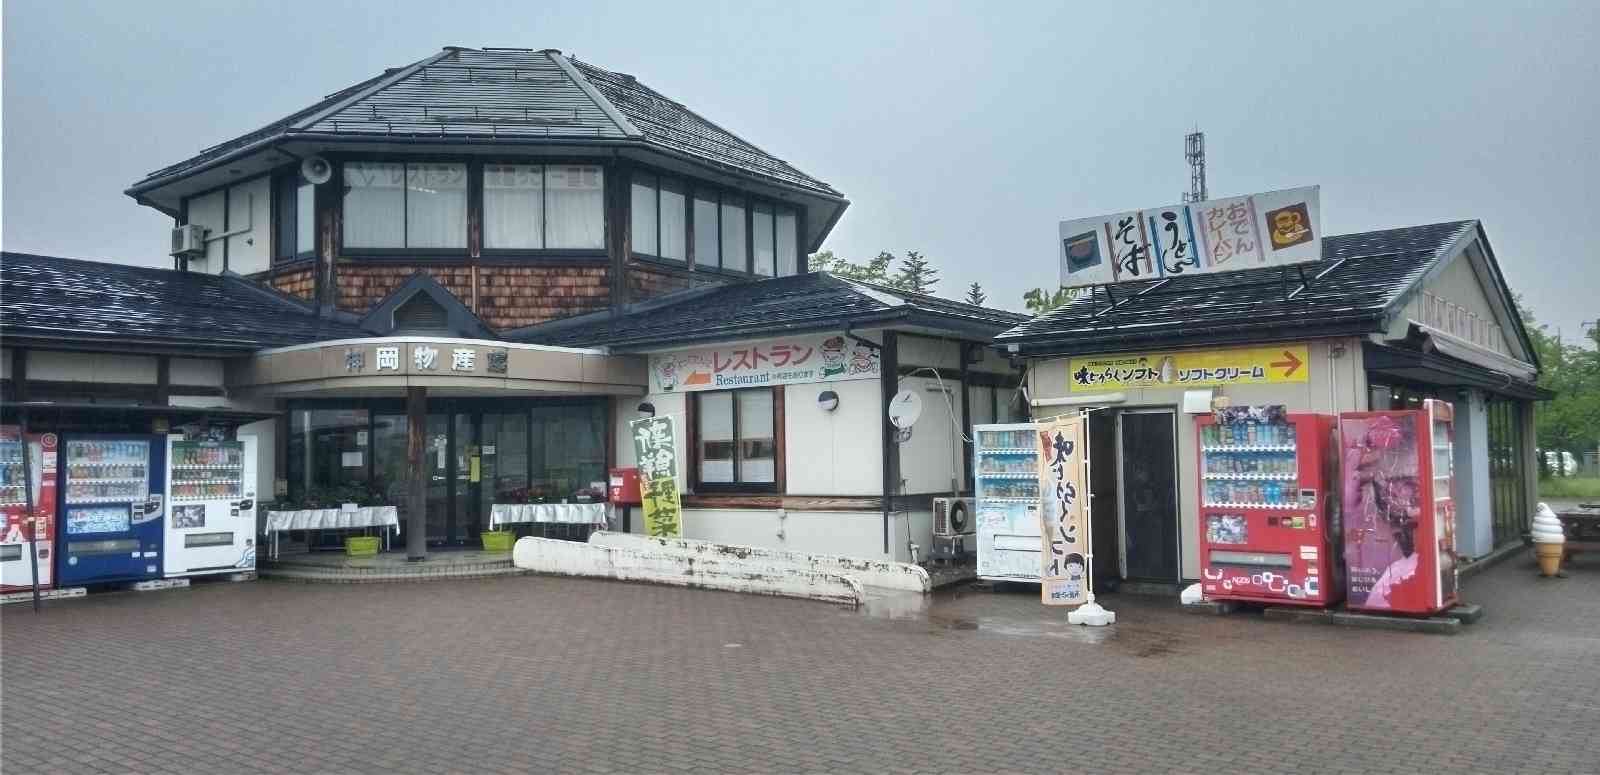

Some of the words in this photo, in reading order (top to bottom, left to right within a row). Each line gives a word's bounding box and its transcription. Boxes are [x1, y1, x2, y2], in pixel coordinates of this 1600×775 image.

[1114, 215, 1152, 277] そば
[1161, 210, 1195, 274] うどん
[712, 343, 814, 373] レストラン
[715, 372, 770, 386] Restaurant
[1179, 366, 1265, 383] ソフトクリーム
